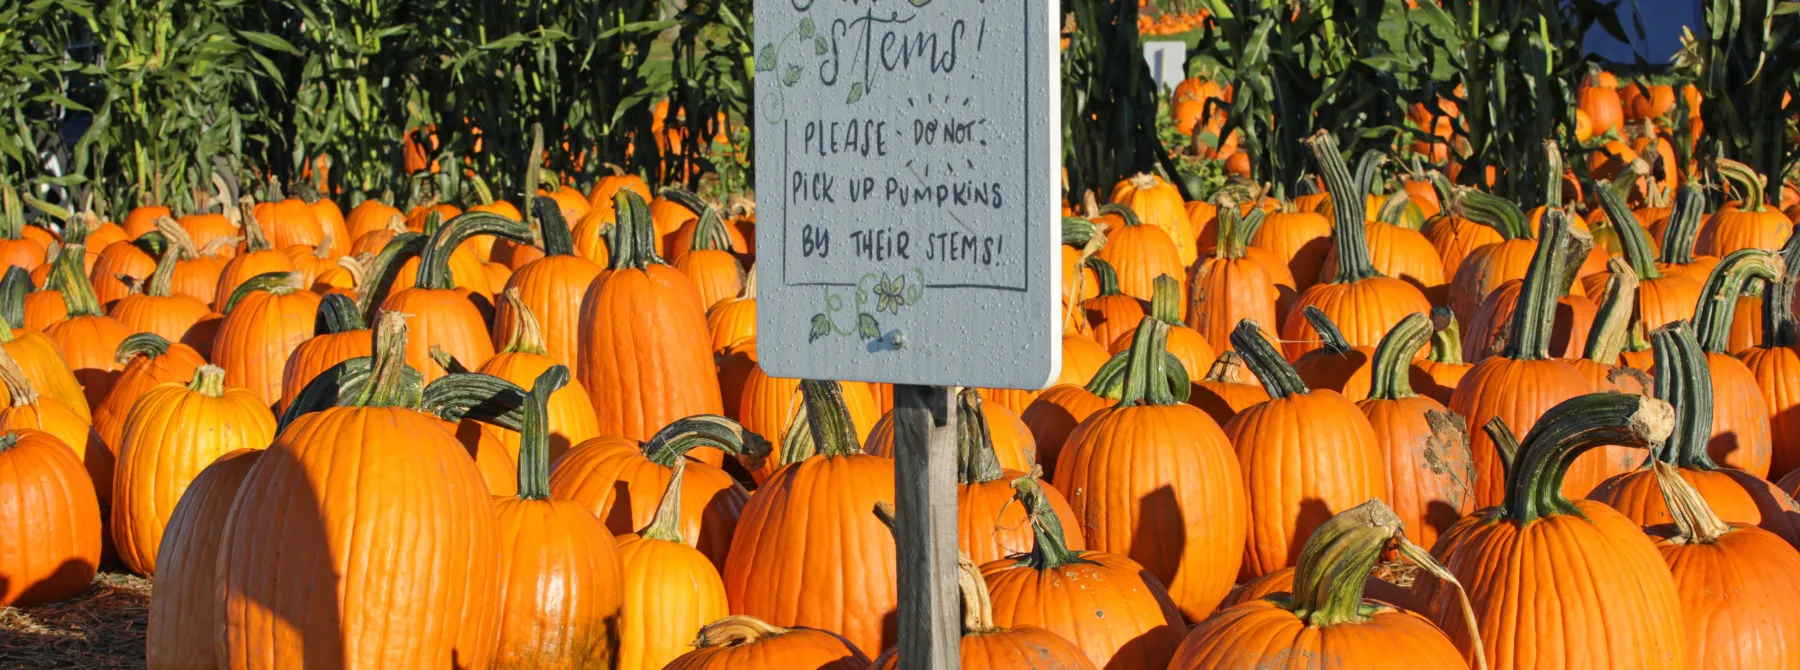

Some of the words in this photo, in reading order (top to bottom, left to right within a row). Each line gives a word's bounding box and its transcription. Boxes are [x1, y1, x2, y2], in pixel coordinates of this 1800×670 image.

[804, 119, 886, 156] PLEASE
[913, 118, 938, 145] DO
[850, 177, 874, 204] UP
[926, 232, 1003, 266] STEMS!
